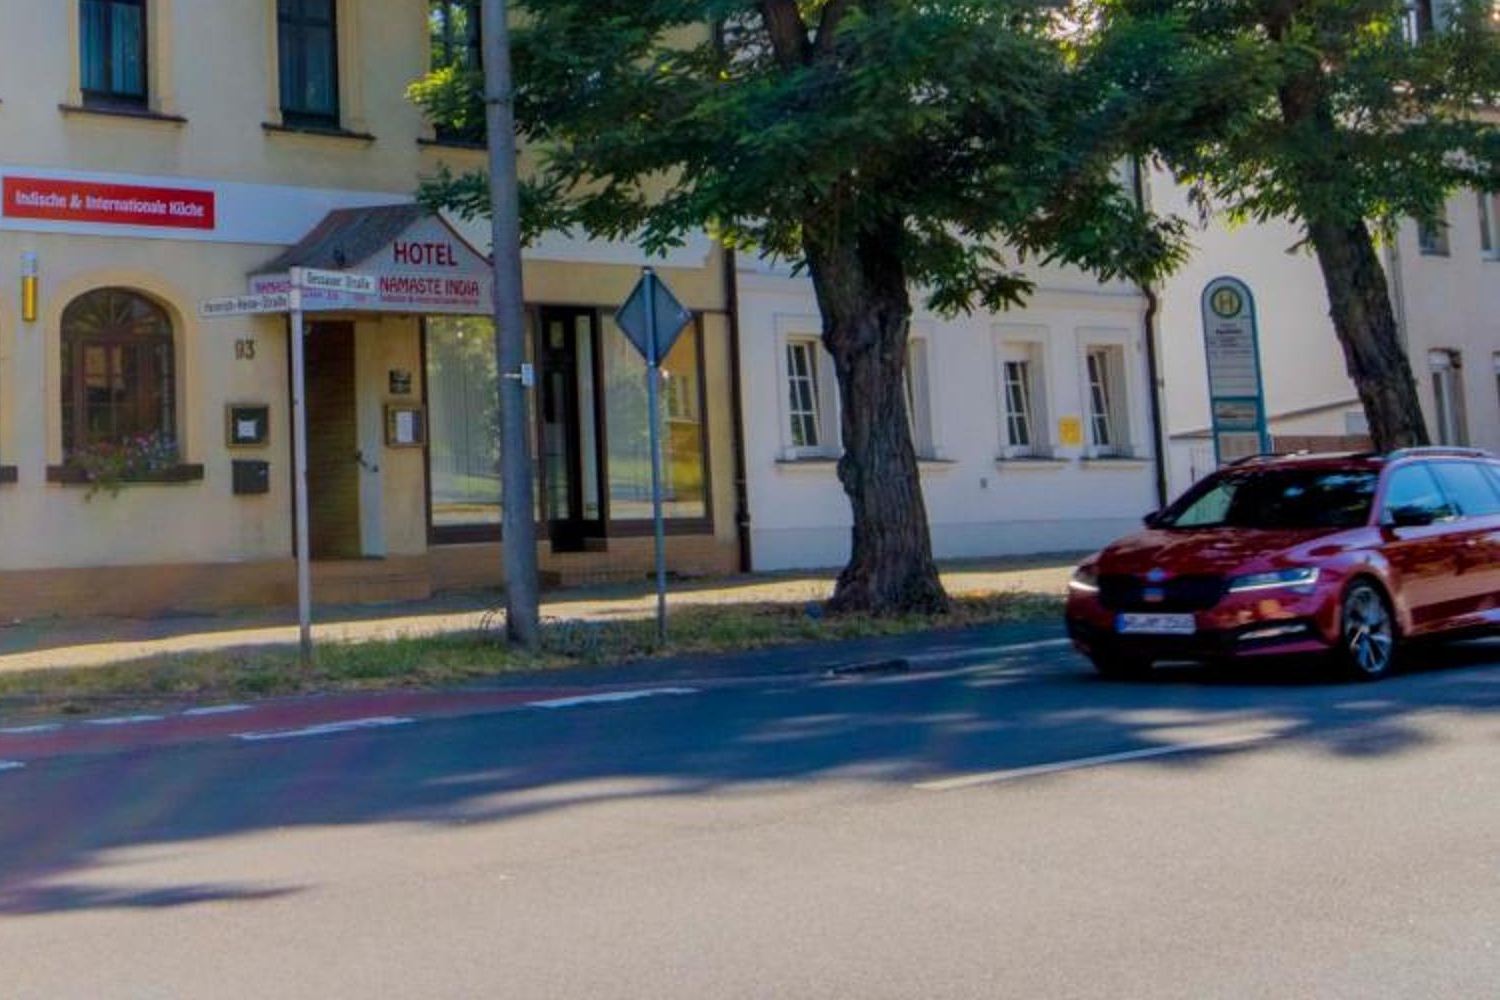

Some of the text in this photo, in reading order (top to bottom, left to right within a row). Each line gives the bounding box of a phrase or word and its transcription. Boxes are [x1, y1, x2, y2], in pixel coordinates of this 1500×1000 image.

[15, 189, 205, 217] Indische & Internationale Küche
[393, 242, 458, 267] HOTEL
[381, 275, 479, 297] NAMASTE INDIA
